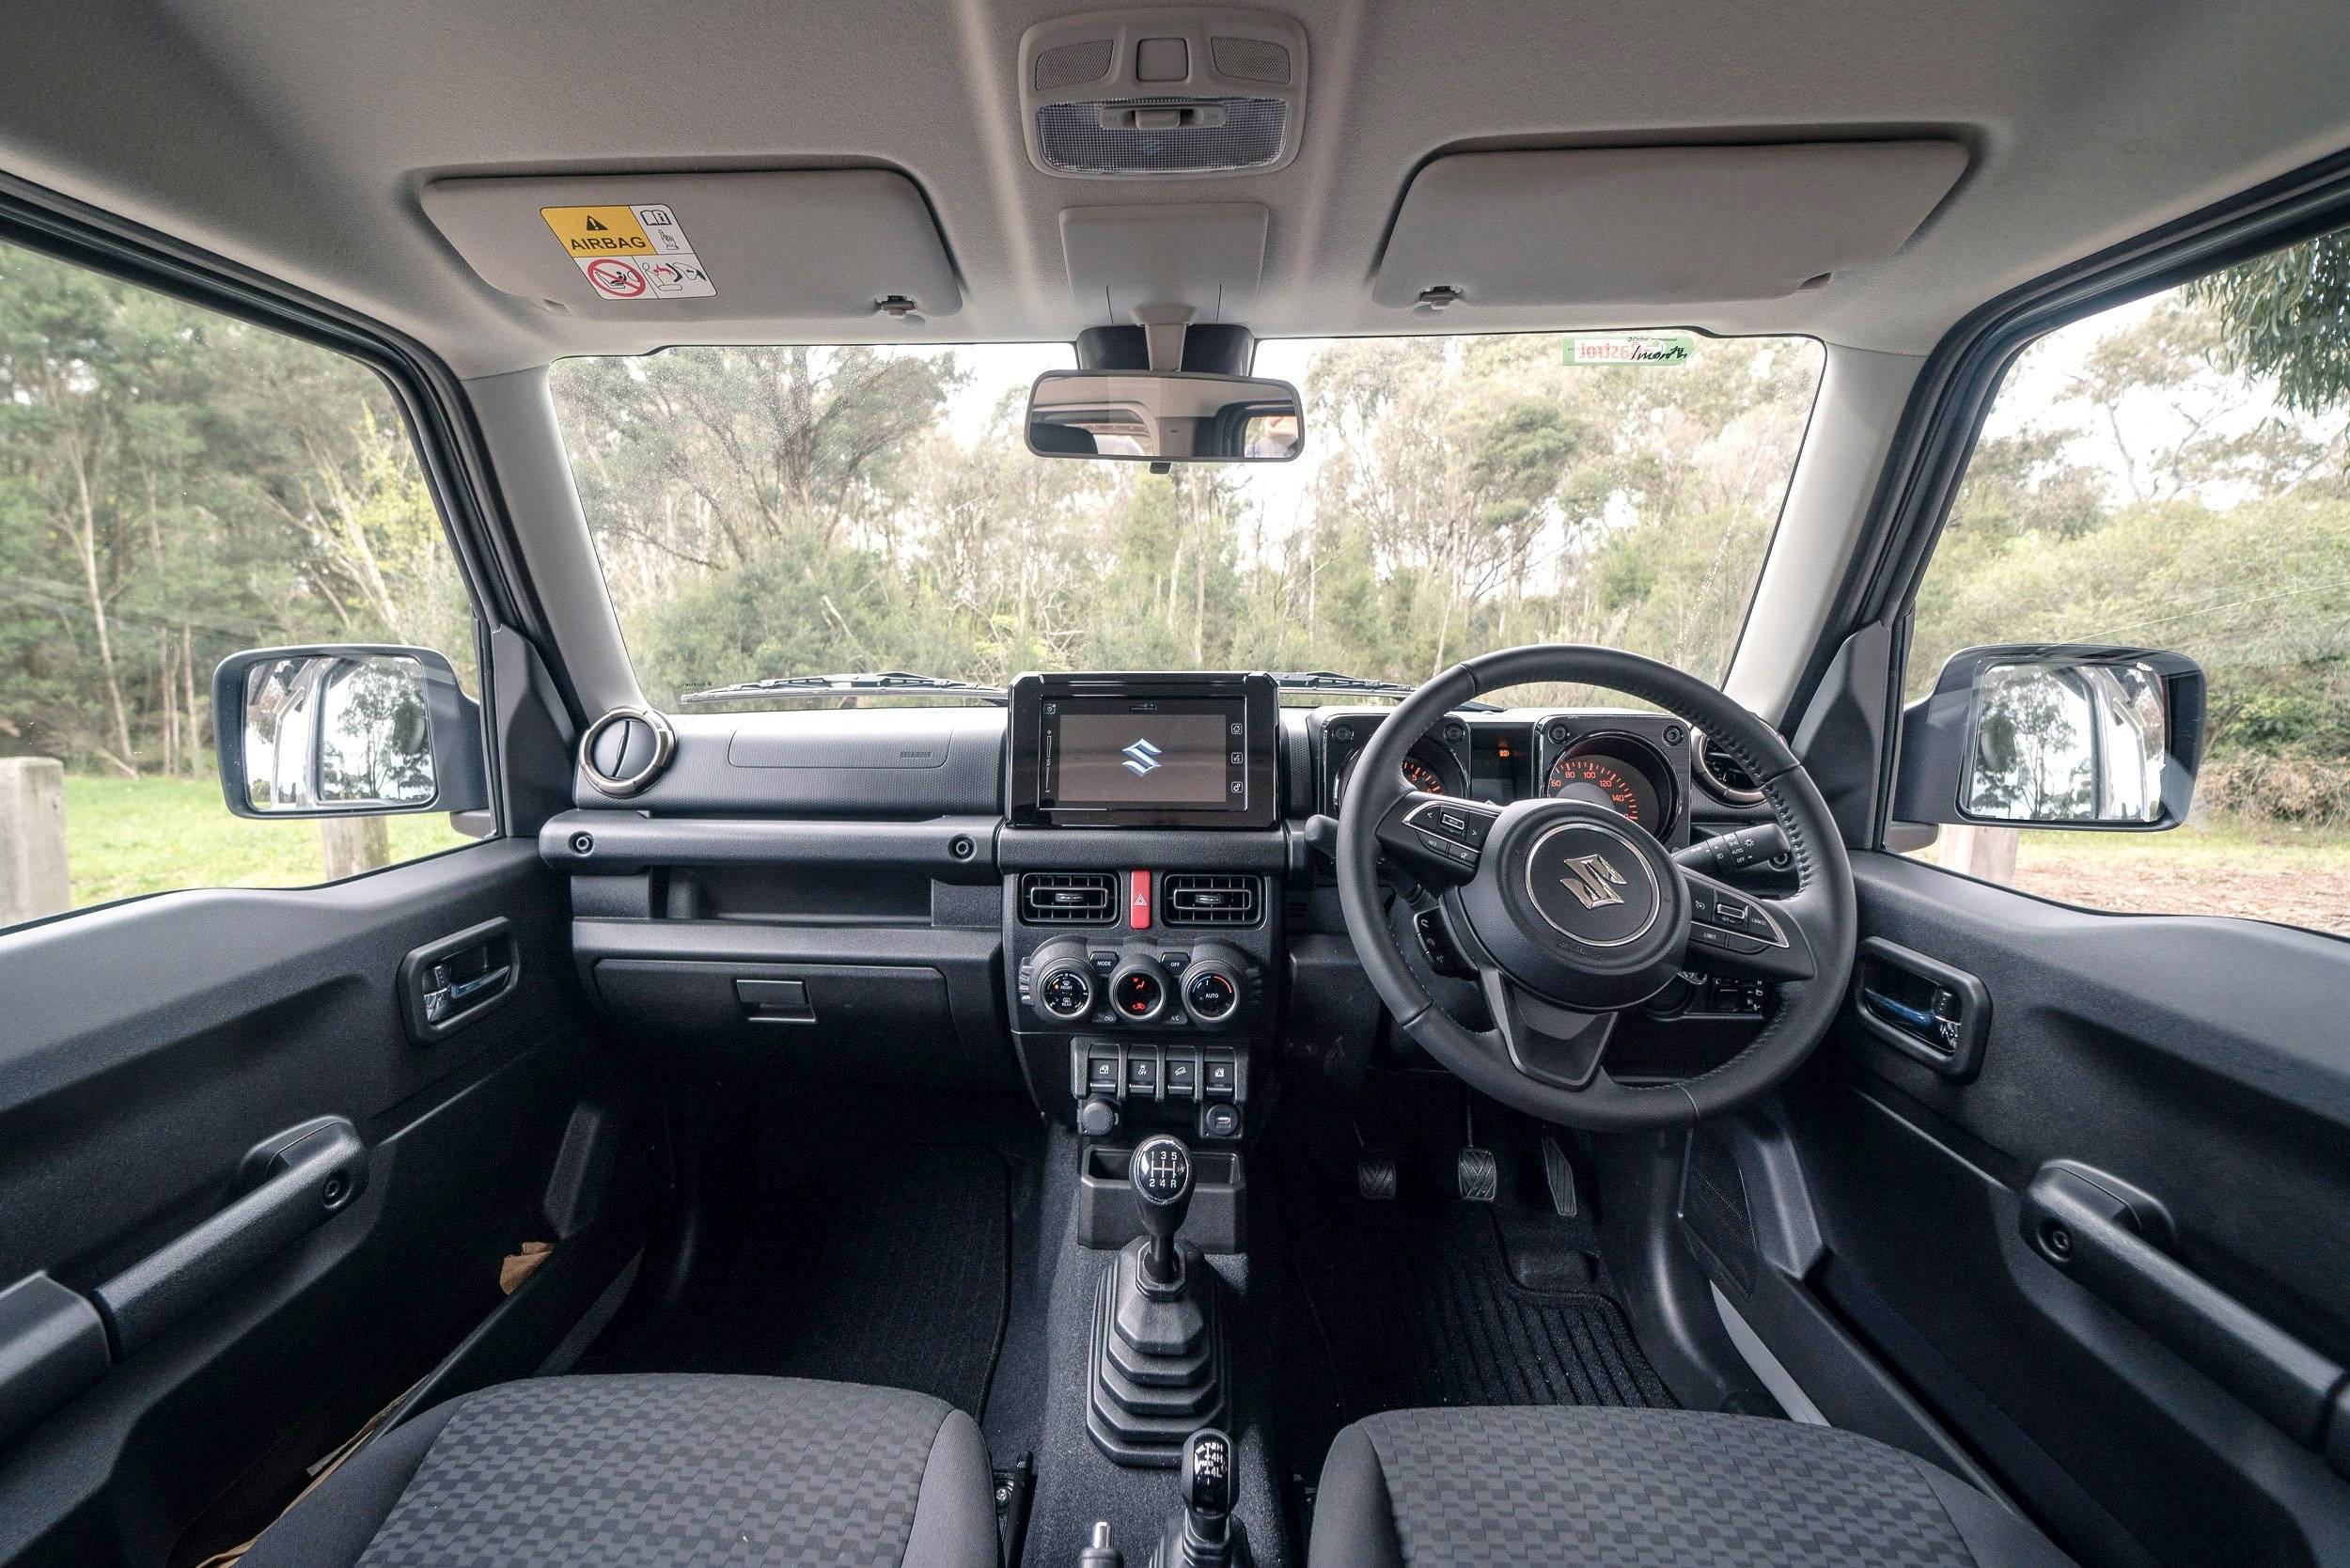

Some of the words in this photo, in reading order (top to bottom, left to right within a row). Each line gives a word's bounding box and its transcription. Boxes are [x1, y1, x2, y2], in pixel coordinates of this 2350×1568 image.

[571, 236, 647, 250] AIRBAG
[1151, 1151, 1154, 1160] 1
[1160, 1151, 1167, 1160] 3
[1171, 1152, 1178, 1161] 5
[1149, 1178, 1155, 1188] 2
[1159, 1179, 1166, 1188] 4
[1170, 1179, 1177, 1188] R
[1211, 1452, 1223, 1463] 4H
[1211, 1466, 1223, 1478] 4L
